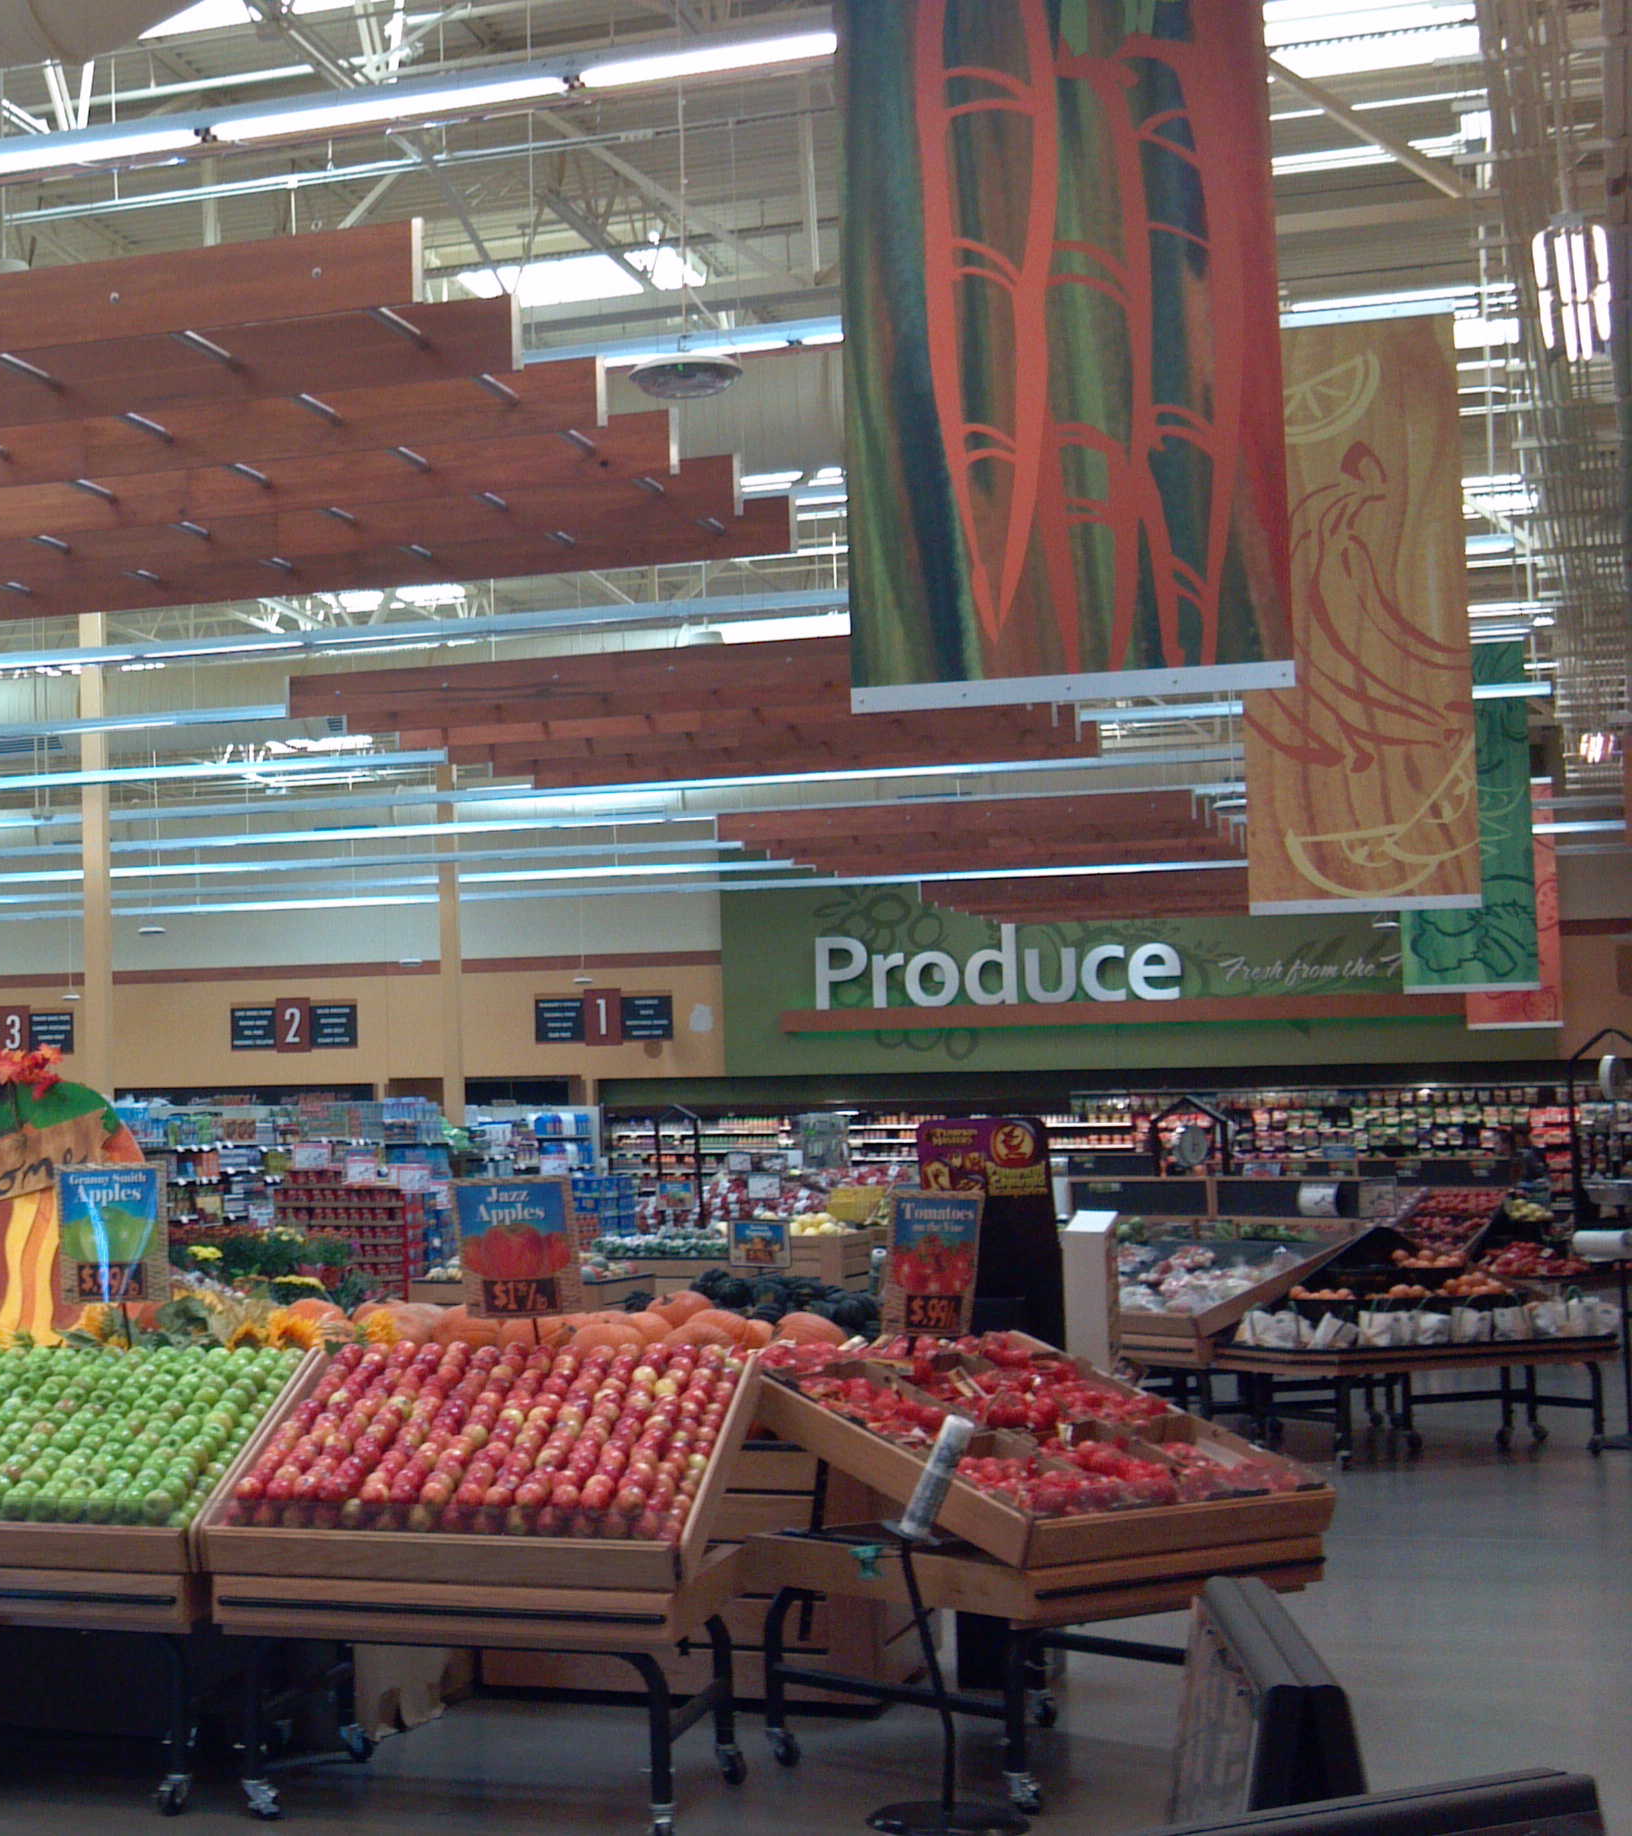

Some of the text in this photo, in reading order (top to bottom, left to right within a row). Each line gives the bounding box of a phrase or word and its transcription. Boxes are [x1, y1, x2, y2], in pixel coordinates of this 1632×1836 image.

[814, 923, 1182, 1010] Produce
[1219, 956, 1283, 982] Fresh
[1285, 959, 1339, 986] from
[1342, 956, 1376, 977] the
[284, 1007, 301, 1043] 2
[596, 998, 607, 1035] 1
[5, 1014, 21, 1049] 3
[69, 1173, 148, 1187] Granny Smith
[77, 1185, 142, 1207] Apples
[486, 1187, 529, 1203] Jazz
[476, 1202, 546, 1226] Apples
[900, 1203, 976, 1221] Tomatoes
